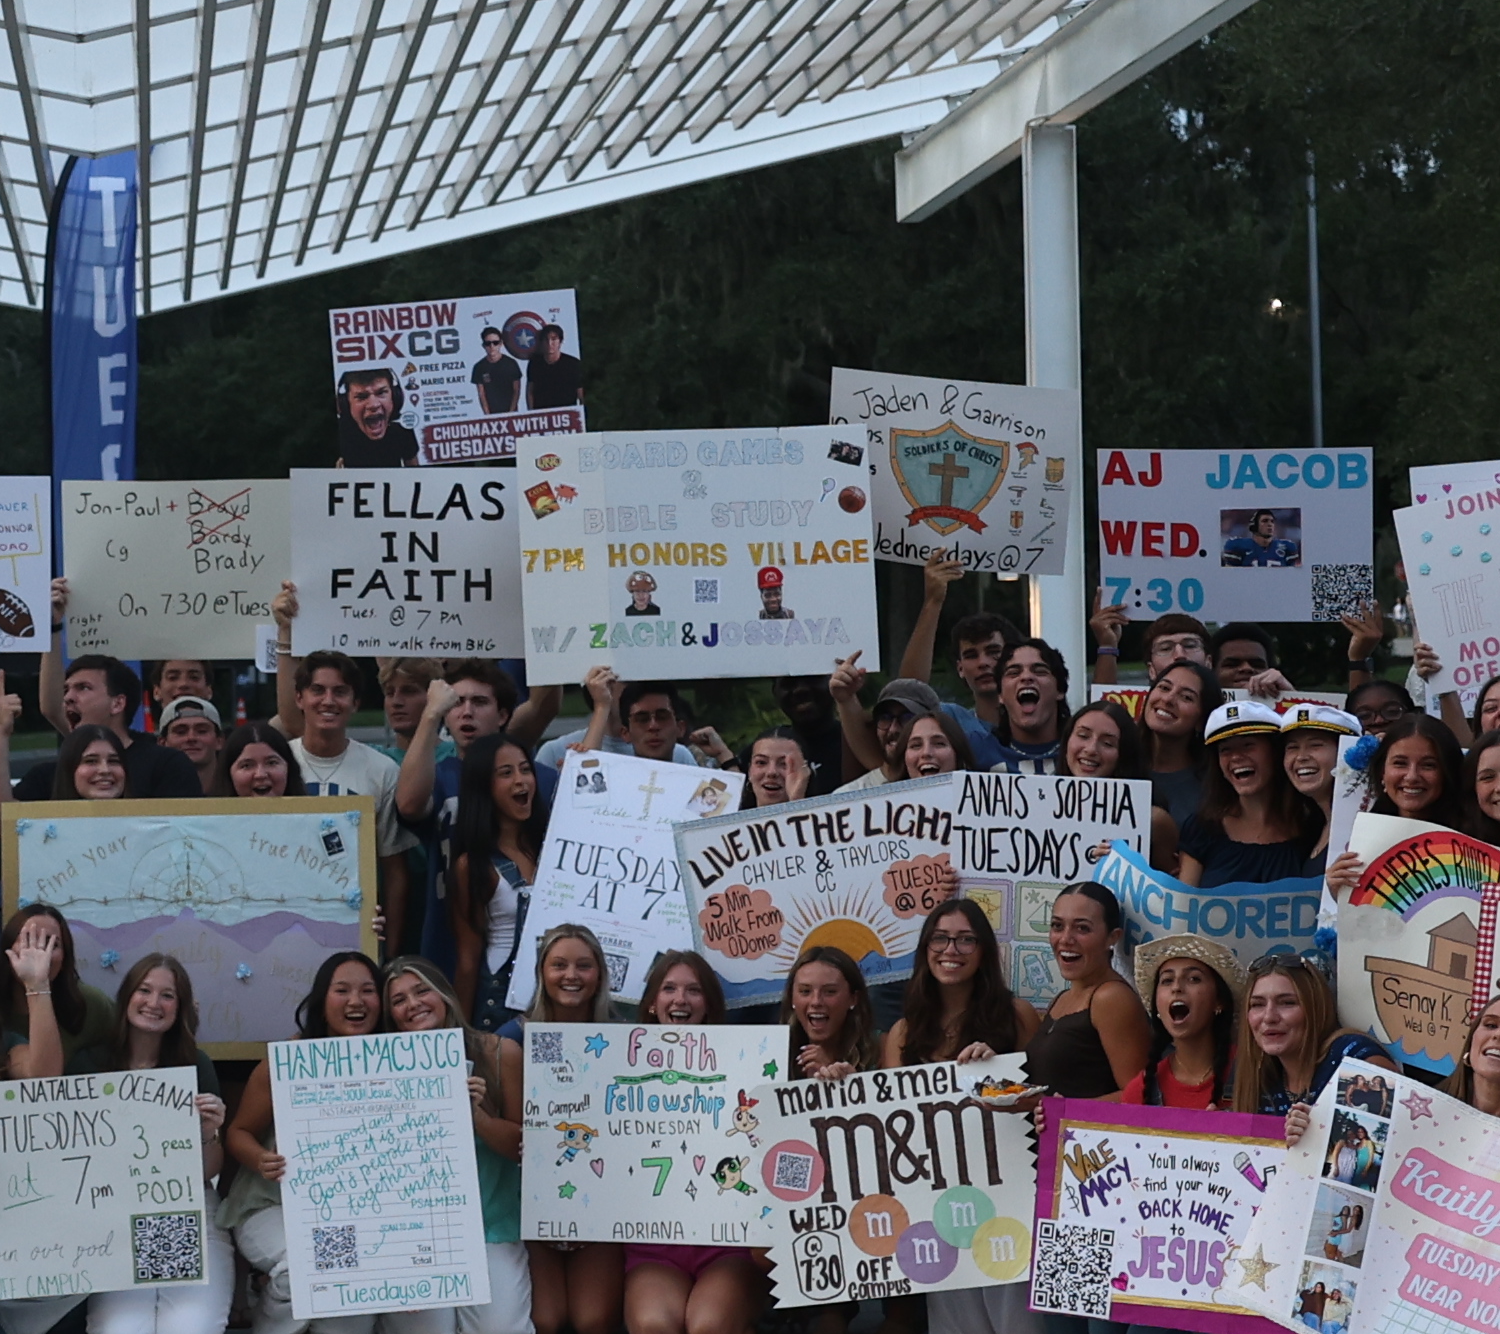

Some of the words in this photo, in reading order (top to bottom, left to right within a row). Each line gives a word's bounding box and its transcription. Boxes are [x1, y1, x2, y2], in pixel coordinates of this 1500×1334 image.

[334, 302, 457, 336] RAINBOW
[420, 363, 439, 372] FREE
[442, 362, 465, 370] PIZZA
[421, 378, 445, 386] MARIO
[447, 375, 465, 384] KART
[433, 423, 508, 441] CHUDMAXX
[513, 418, 549, 432] WITH
[552, 414, 570, 426] US
[853, 385, 928, 419] Jaden
[940, 385, 959, 415] &
[963, 392, 1045, 440] Garrison
[428, 436, 515, 460] TUESDAYS
[578, 441, 688, 472] BOARD
[697, 438, 804, 466] GAMES
[904, 438, 949, 457] SOLDIERS
[953, 440, 965, 452] OF
[968, 446, 1001, 467] CHRIST
[1102, 451, 1162, 487] AJ
[1206, 453, 1367, 490] JACOB
[328, 482, 505, 521] FELLAS
[584, 504, 677, 534] BIBLE
[711, 500, 814, 528] STUDY
[381, 531, 439, 563] IN
[1101, 521, 1207, 558] WED.
[331, 569, 492, 601] FAITH
[1105, 577, 1204, 612] 7:30
[331, 634, 349, 648] 10
[358, 637, 381, 648] min
[389, 637, 424, 652] walk
[429, 638, 461, 651] from
[466, 638, 496, 652] BHG
[590, 621, 676, 648] ZACH
[682, 622, 698, 645] &
[702, 617, 849, 647] JOSSAYA
[959, 774, 1029, 819] ANAIS
[1038, 789, 1046, 801] &
[1053, 778, 1136, 827] SOPHIA
[953, 825, 1080, 879] TUESDAYS
[608, 1120, 702, 1136] WEDNESDAY
[136, 1177, 195, 1204] POD!
[789, 1205, 847, 1232] WED
[1139, 1199, 1182, 1220] BACK
[1189, 1201, 1234, 1235] HOME
[1127, 1236, 1226, 1288] JESUS
[1408, 1274, 1463, 1311] NEAR
